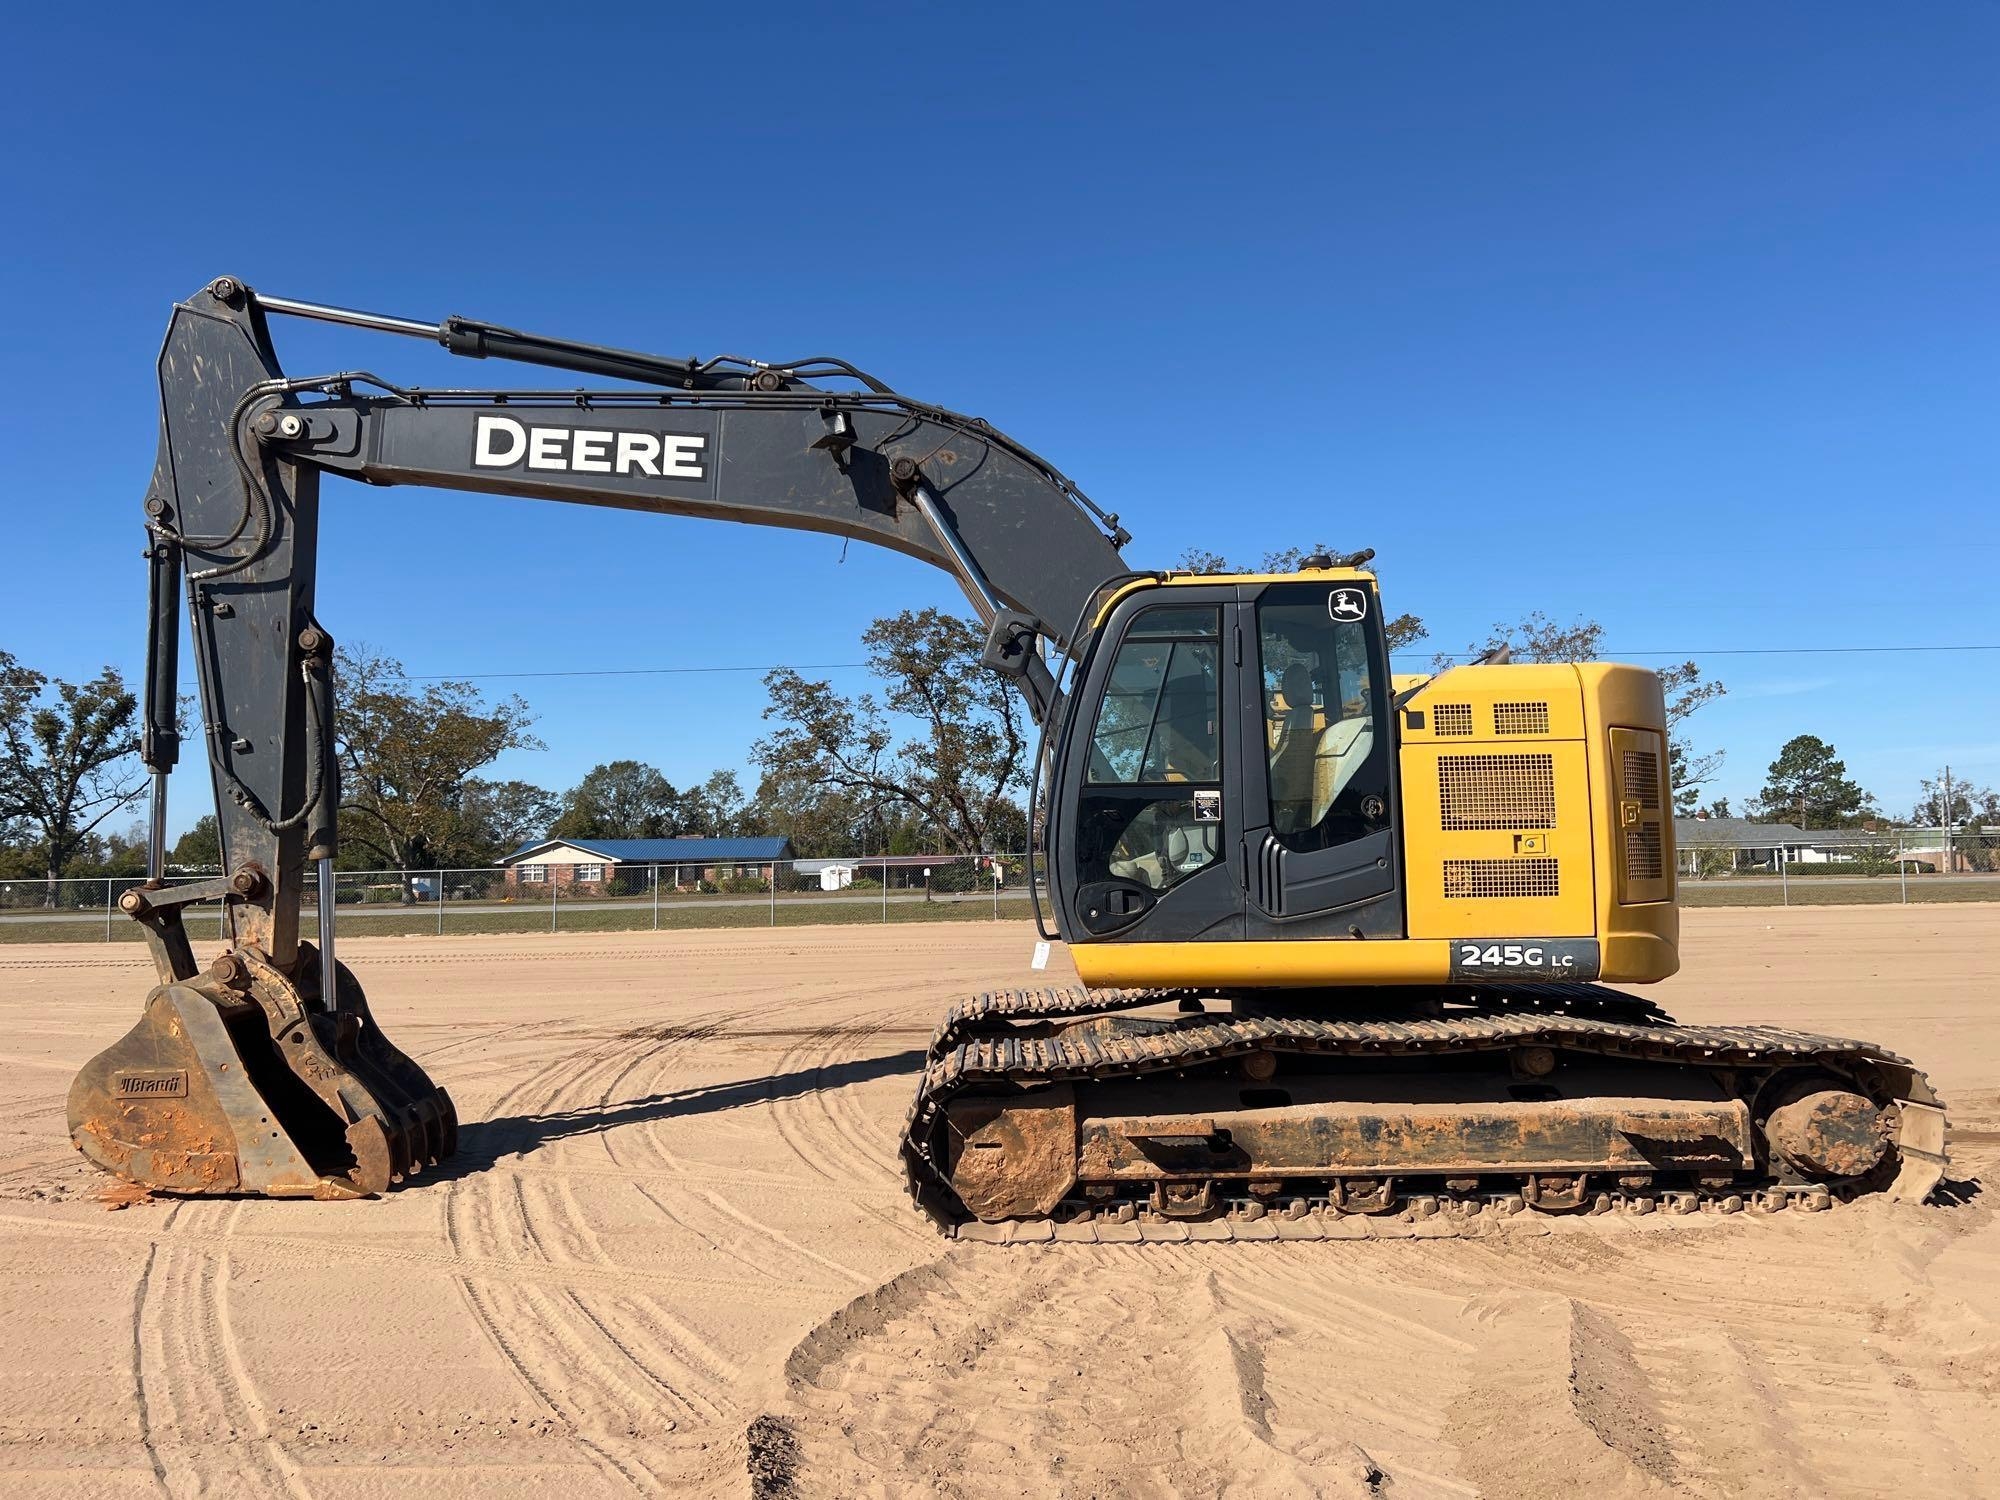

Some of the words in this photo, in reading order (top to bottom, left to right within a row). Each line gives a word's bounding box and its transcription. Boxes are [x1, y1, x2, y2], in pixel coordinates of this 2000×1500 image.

[475, 416, 705, 478] DEERE
[1461, 945, 1543, 966] 245G
[1552, 956, 1574, 967] LC
